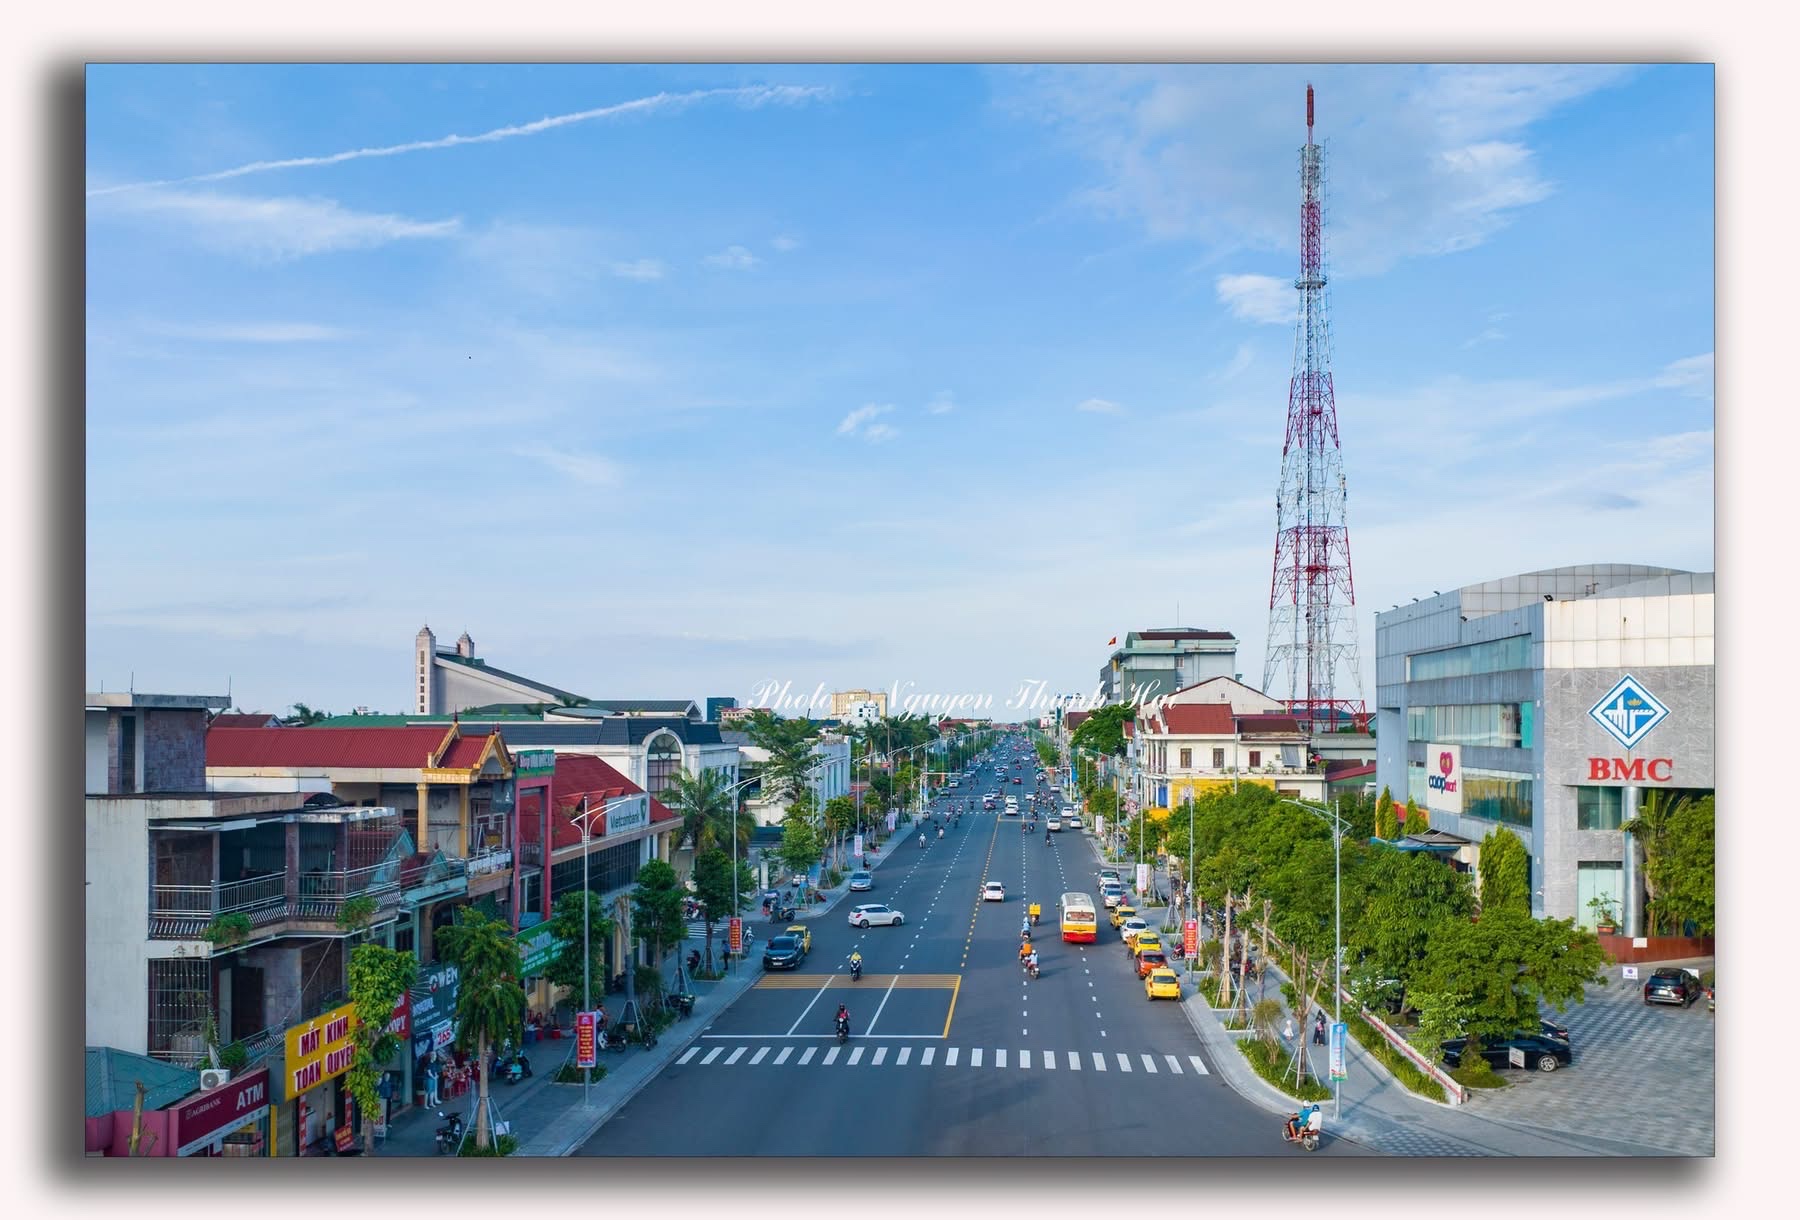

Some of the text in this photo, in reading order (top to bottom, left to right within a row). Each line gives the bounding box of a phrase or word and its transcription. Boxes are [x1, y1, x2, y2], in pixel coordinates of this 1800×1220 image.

[1587, 757, 1674, 782] BMC
[429, 967, 458, 993] OWEN
[236, 1082, 264, 1111] ATM
